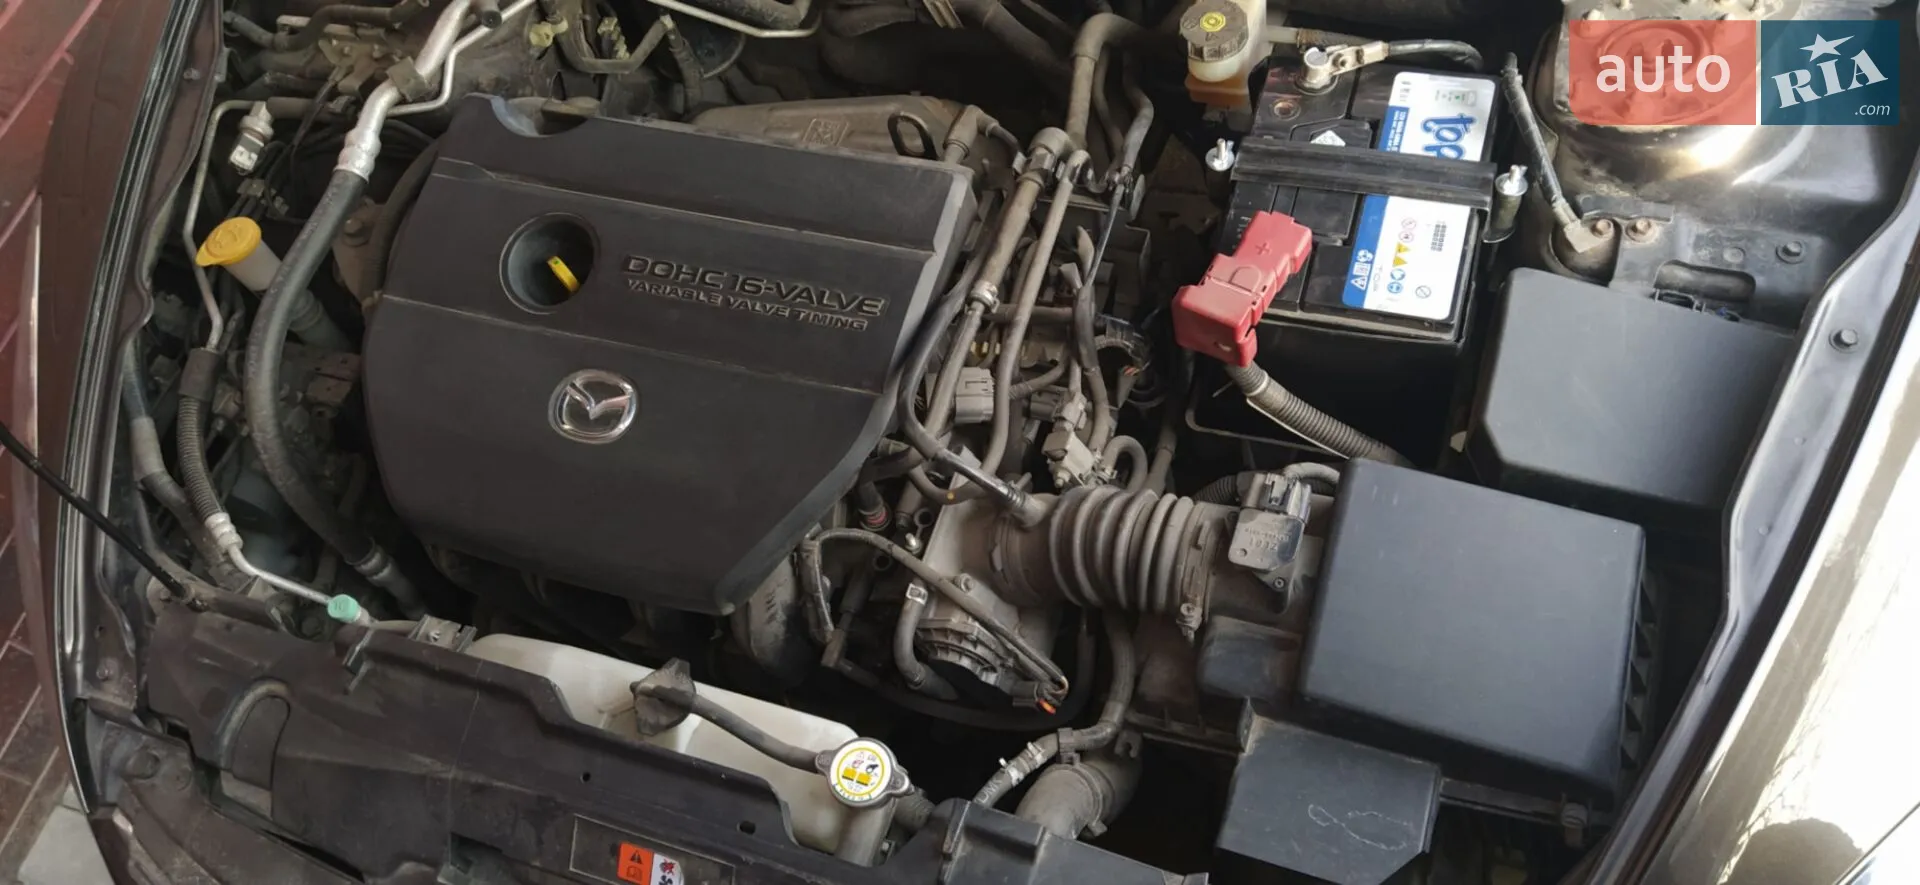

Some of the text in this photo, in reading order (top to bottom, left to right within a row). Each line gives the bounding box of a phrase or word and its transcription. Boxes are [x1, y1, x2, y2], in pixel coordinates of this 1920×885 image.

[624, 255, 885, 317] DOHC 16-VALVE
[628, 278, 868, 331] VARIABLE VALVE TIMING
